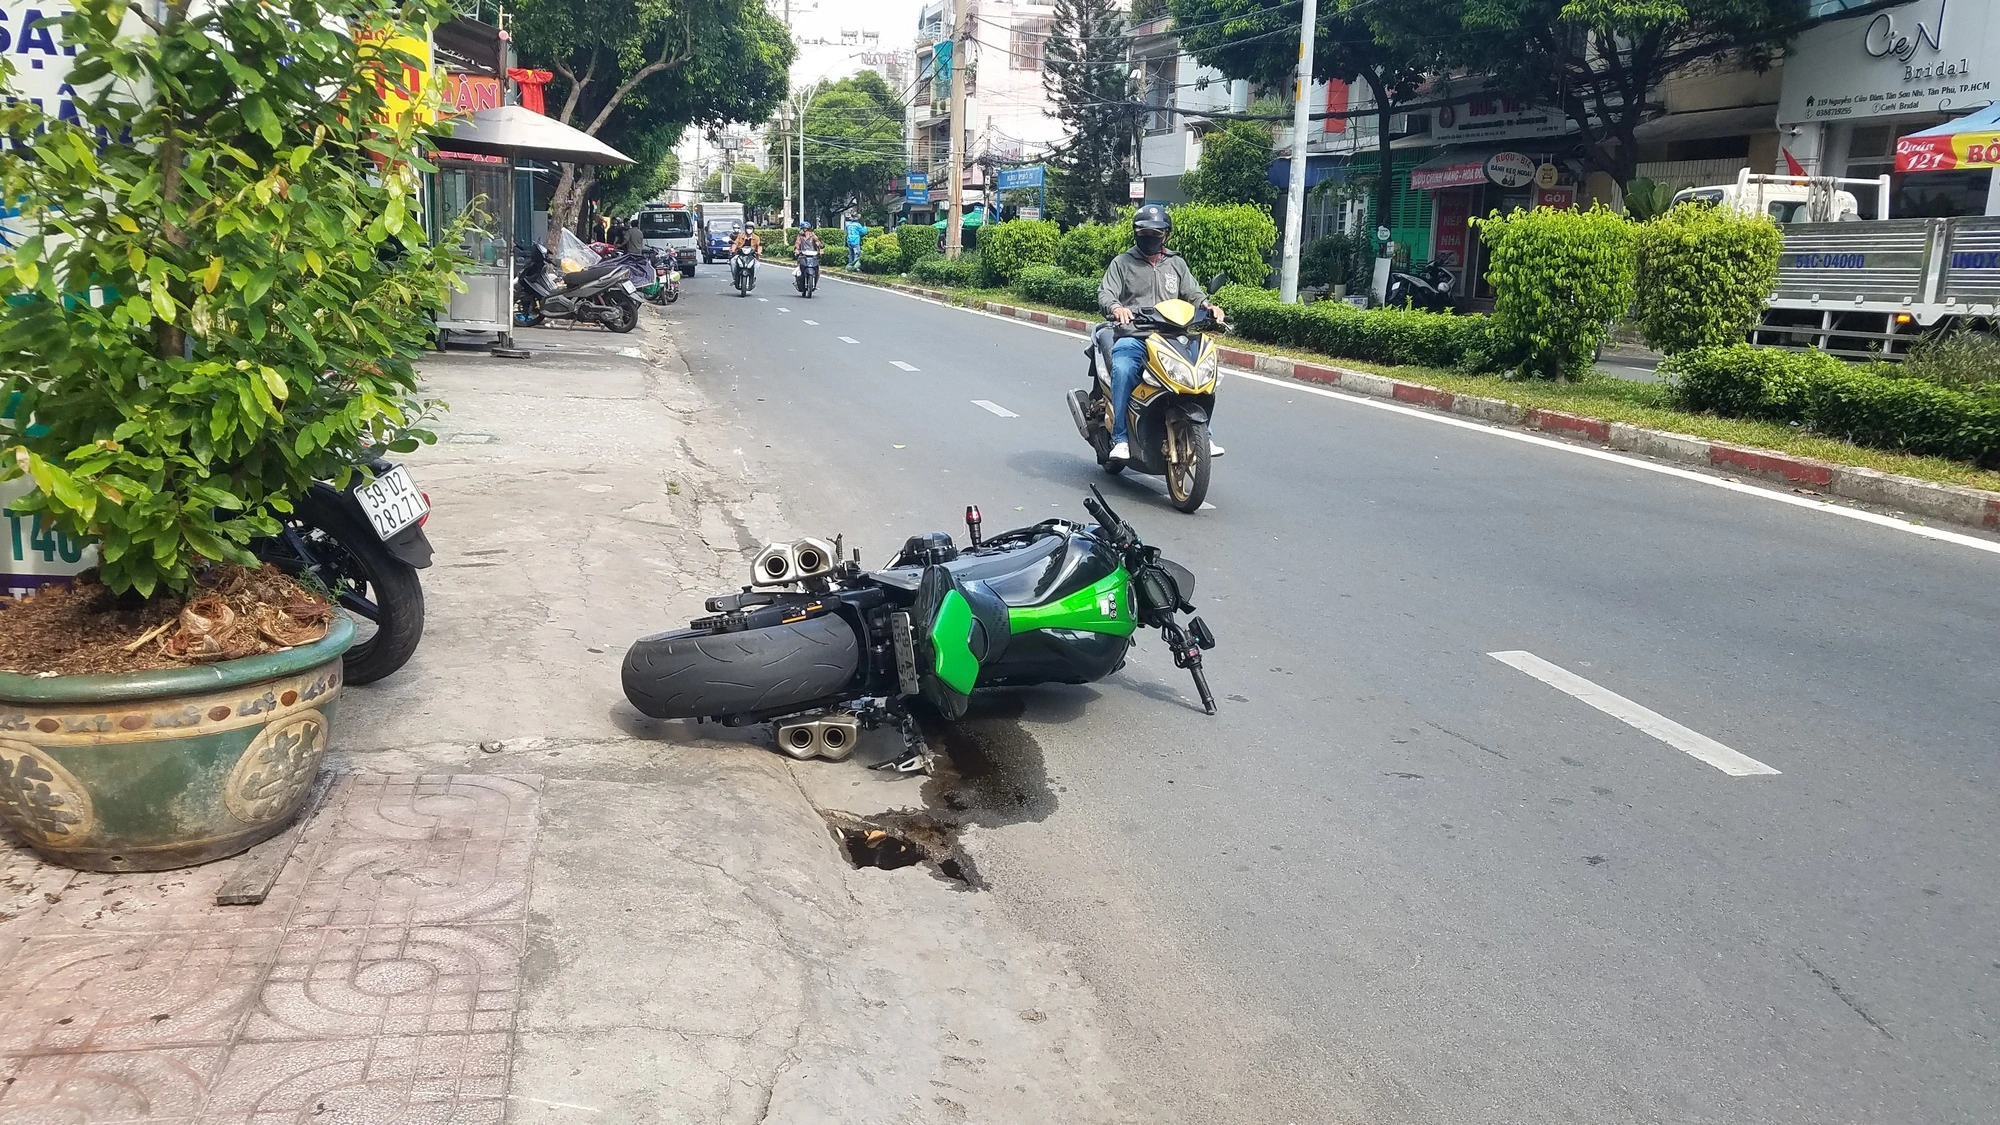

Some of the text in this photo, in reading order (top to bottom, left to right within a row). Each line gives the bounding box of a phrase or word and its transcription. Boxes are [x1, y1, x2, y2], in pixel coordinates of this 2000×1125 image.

[1865, 0, 1945, 62] CieN
[1903, 58, 1969, 81] Bridal
[1817, 98, 1828, 107] 119
[1959, 81, 1991, 93] TP.HCM
[1896, 140, 1936, 155] Quán
[1906, 152, 1945, 170] 121
[1952, 252, 1999, 269] INOX
[373, 491, 424, 536] 282.71
